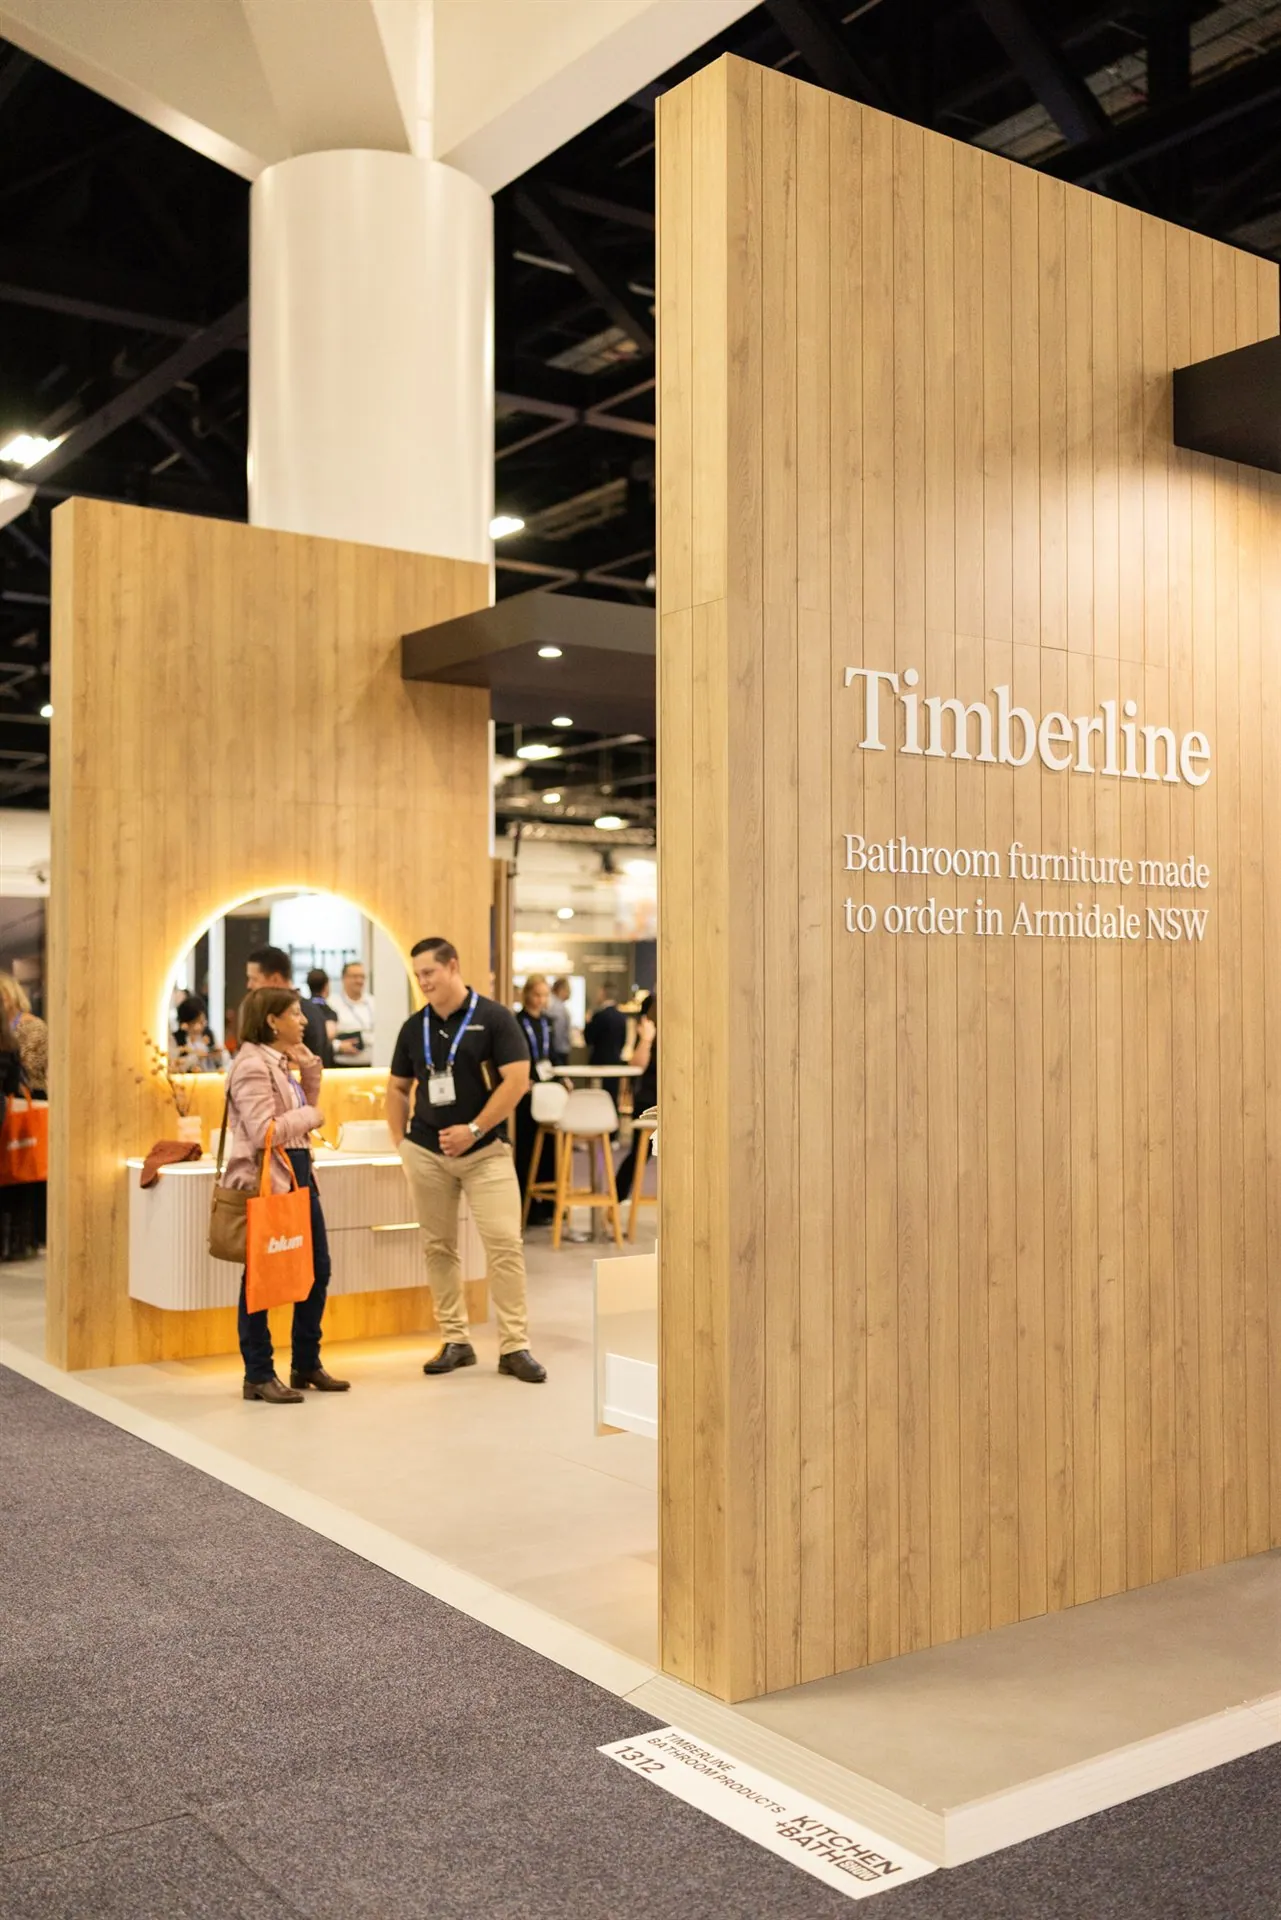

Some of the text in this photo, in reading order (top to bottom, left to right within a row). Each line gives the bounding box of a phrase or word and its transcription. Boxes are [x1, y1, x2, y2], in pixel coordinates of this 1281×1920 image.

[844, 667, 1211, 786] Timberline
[842, 834, 1210, 888] Bathroom furniture made
[843, 897, 1209, 941] to order in Armidale NSW
[267, 1235, 303, 1254] blum
[614, 1745, 666, 1774] 1312
[646, 1738, 786, 1815] BATHROOM PRODUCTS
[663, 1733, 736, 1772] TIMBERLINE
[790, 1815, 903, 1876] KITCHEN
